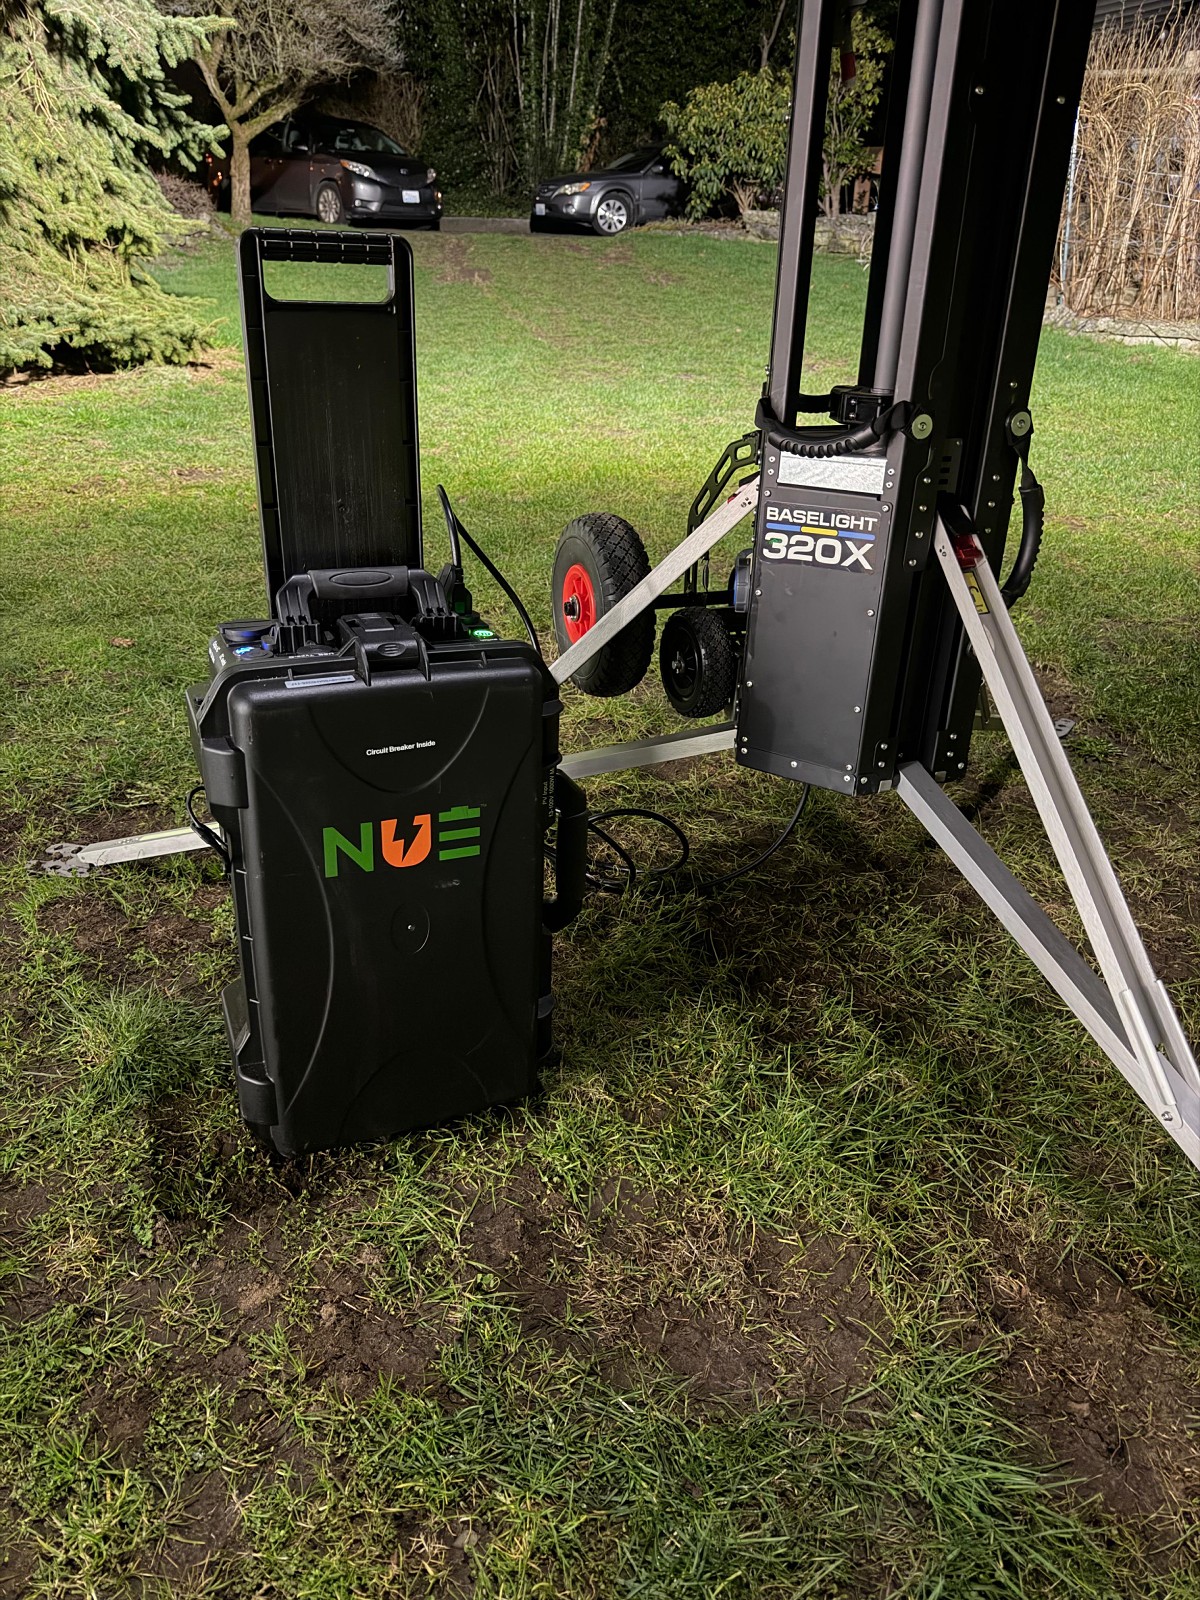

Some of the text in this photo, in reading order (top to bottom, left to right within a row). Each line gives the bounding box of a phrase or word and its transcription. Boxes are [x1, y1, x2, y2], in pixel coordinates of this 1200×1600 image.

[766, 506, 878, 531] BASELIGHT
[762, 532, 874, 570] 320X
[366, 740, 436, 756] Circuit Breaker Inside
[322, 805, 481, 879] NUE
